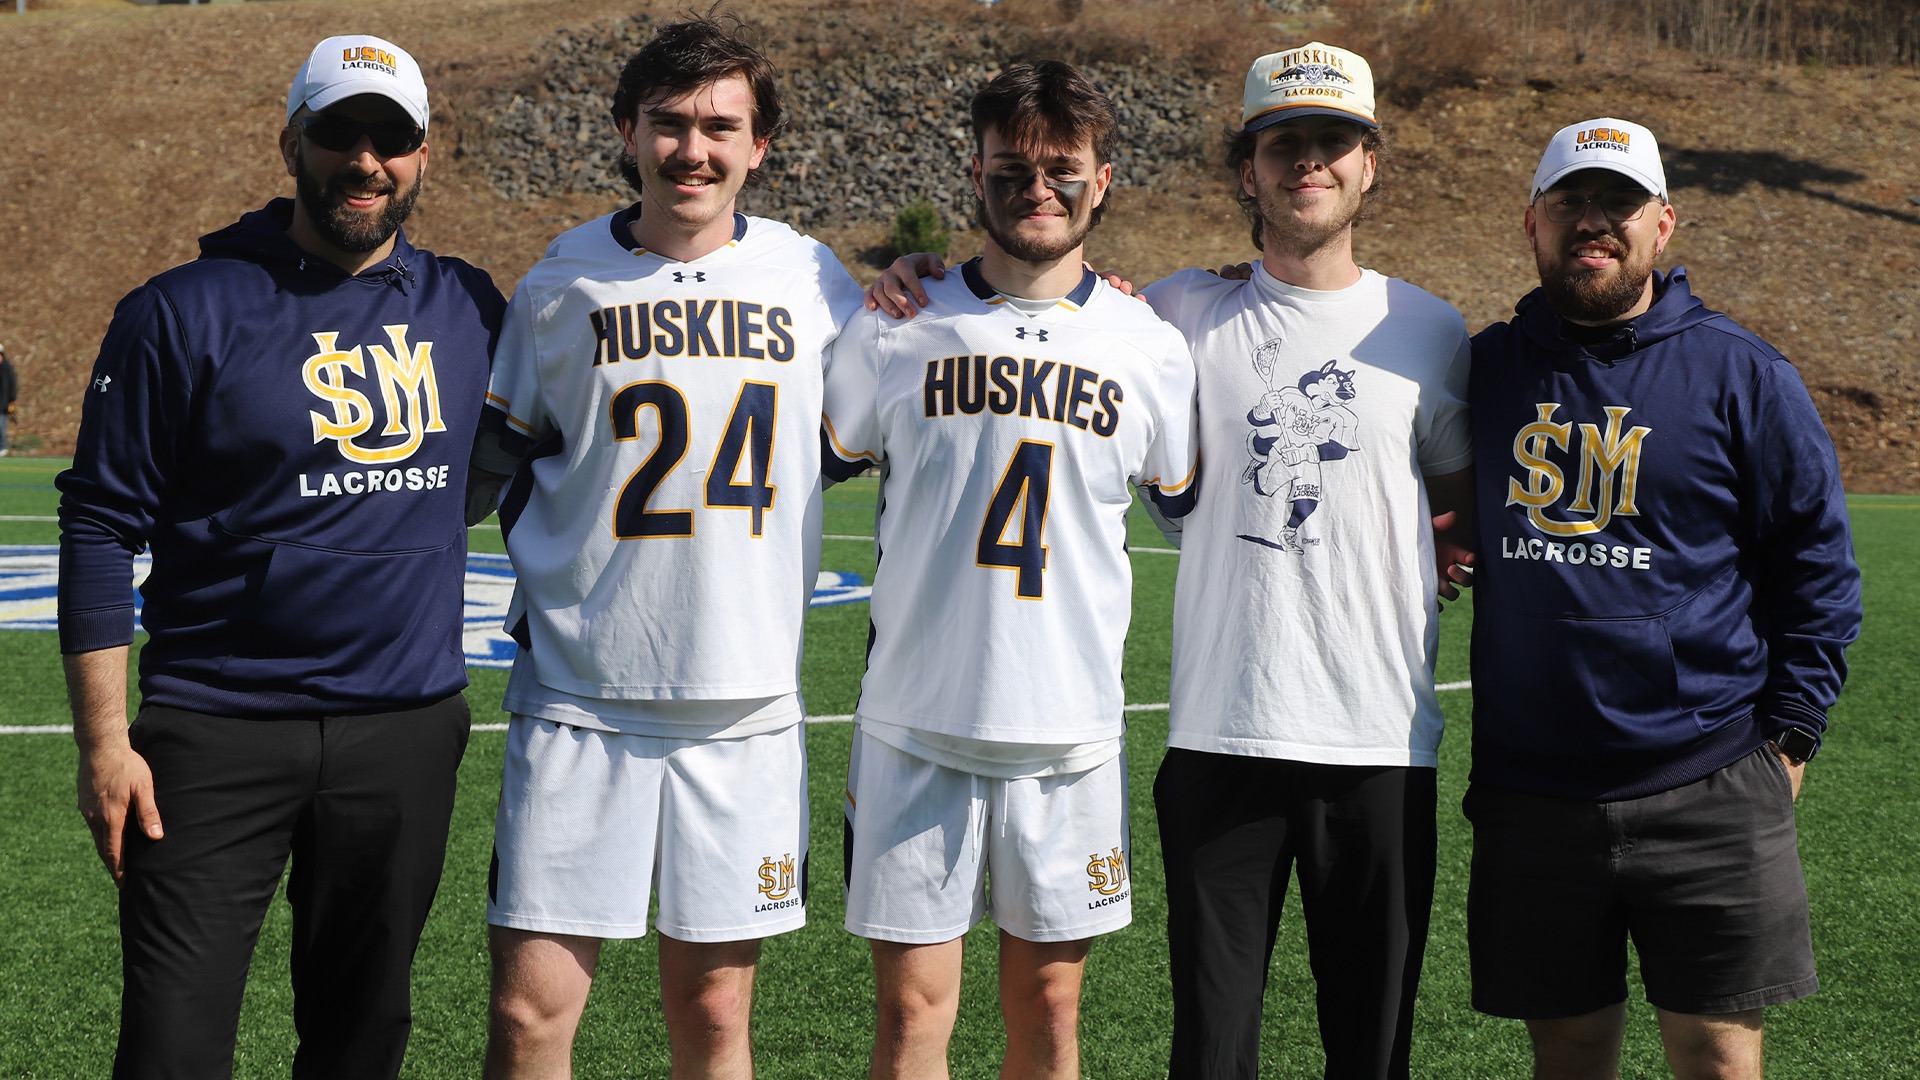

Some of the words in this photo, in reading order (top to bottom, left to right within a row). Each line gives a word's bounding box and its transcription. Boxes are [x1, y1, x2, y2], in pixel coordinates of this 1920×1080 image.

[342, 61, 398, 77] LACROSSE
[343, 46, 396, 69] USM
[1281, 49, 1344, 71] HUSKIES
[1283, 87, 1343, 99] LACROSSE
[1575, 141, 1630, 154] LACROSSE
[1577, 127, 1630, 146] USM
[589, 299, 795, 368] HUSKIES
[924, 354, 1124, 438] HUSKIES
[609, 378, 779, 541] 24
[299, 465, 449, 497] LACROSSE
[975, 438, 1055, 601] 4
[1502, 536, 1652, 570] LACROSSE
[755, 897, 799, 913] LACROSSE
